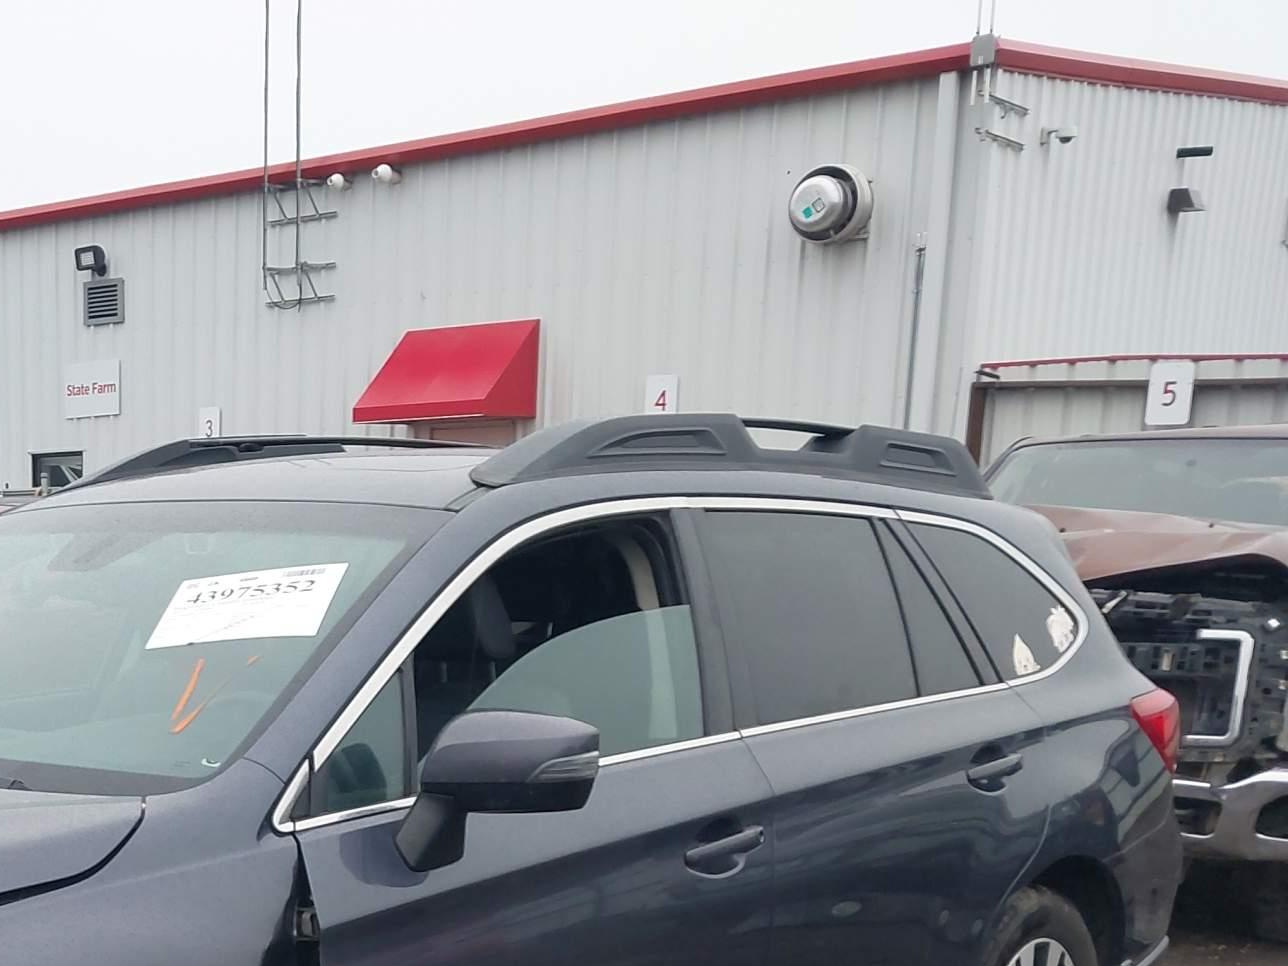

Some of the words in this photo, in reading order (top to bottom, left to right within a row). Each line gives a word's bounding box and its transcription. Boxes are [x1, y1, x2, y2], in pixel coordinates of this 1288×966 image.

[66, 384, 90, 397] State
[91, 382, 116, 394] Farm
[654, 389, 667, 411] 4
[1161, 381, 1177, 407] 5
[205, 419, 213, 438] 3
[186, 579, 317, 604] 43975352
